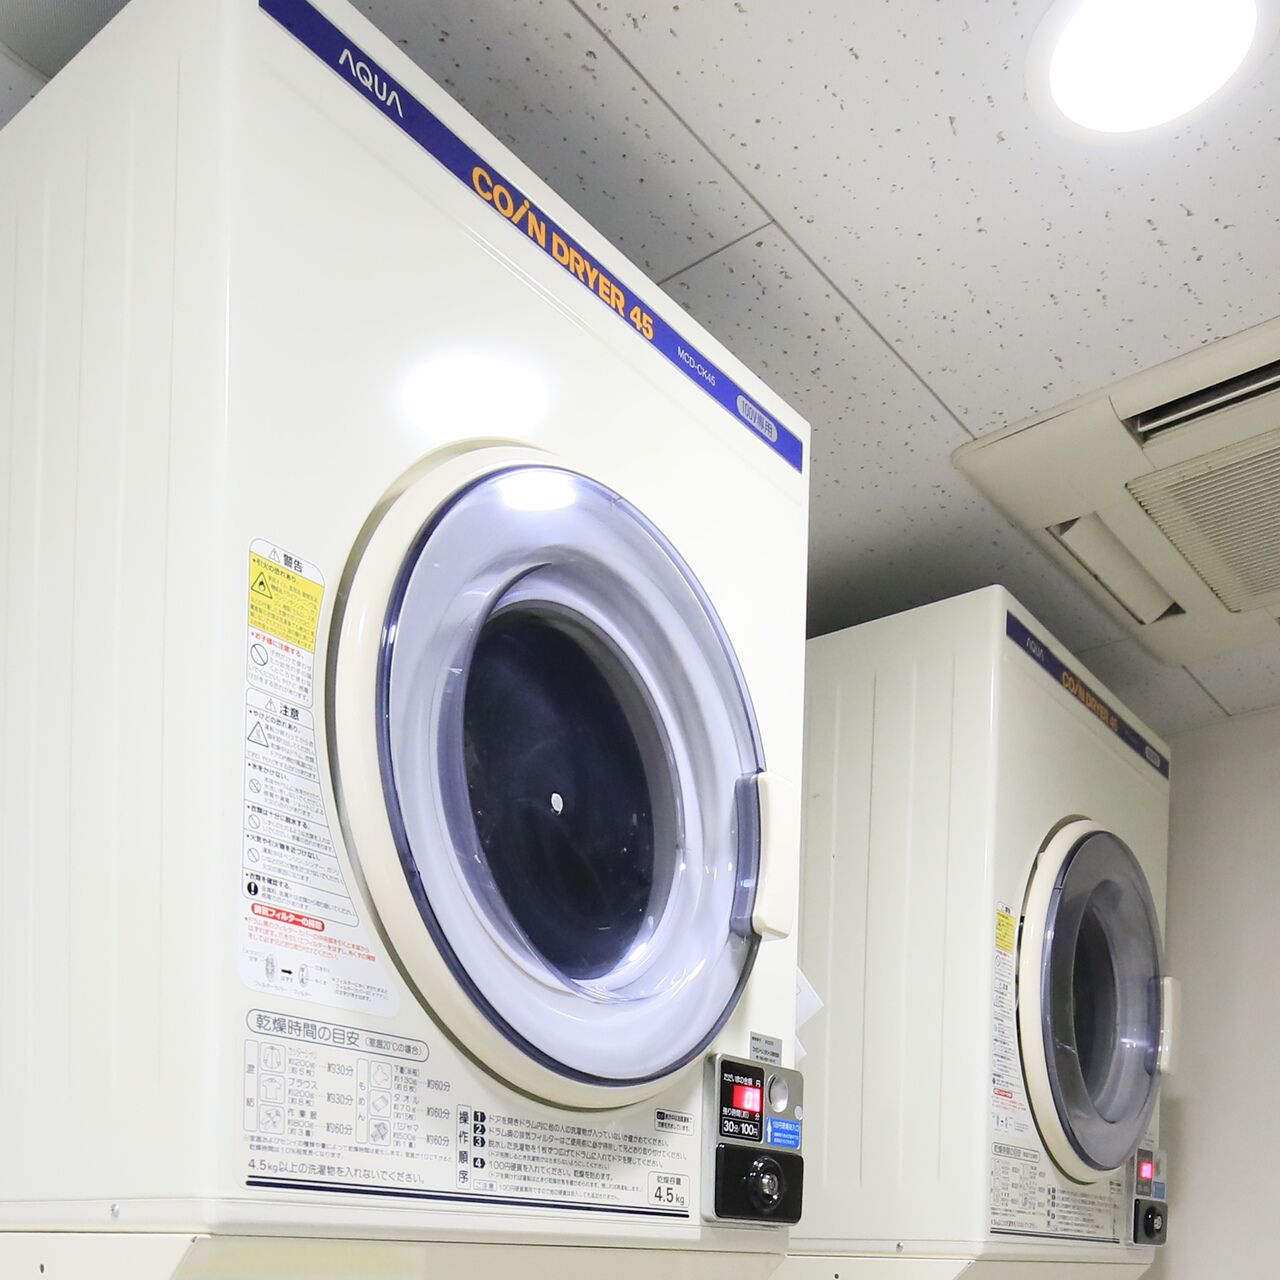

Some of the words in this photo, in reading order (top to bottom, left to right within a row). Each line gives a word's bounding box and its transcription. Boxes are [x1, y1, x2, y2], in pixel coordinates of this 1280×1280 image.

[339, 47, 405, 119] AQUA
[551, 230, 626, 317] DRYER
[629, 306, 654, 342] 45
[283, 554, 303, 574] 警告
[1026, 637, 1044, 662] AQUA
[279, 701, 299, 722] 注意
[1085, 693, 1110, 723] DRYER
[255, 1012, 360, 1048] 乾燥時間の目安
[287, 1076, 318, 1090] ブラウス
[755, 1078, 761, 1088] 円
[393, 1093, 420, 1104] タオル
[744, 1091, 753, 1108] 0
[457, 1109, 470, 1184] 操作順序
[247, 1156, 425, 1186] 4.5kg以上の洗濯物を入れないでください。
[656, 1174, 681, 1186] 乾燥容量
[654, 1185, 673, 1204] 4.5
[675, 1193, 684, 1205] kg
